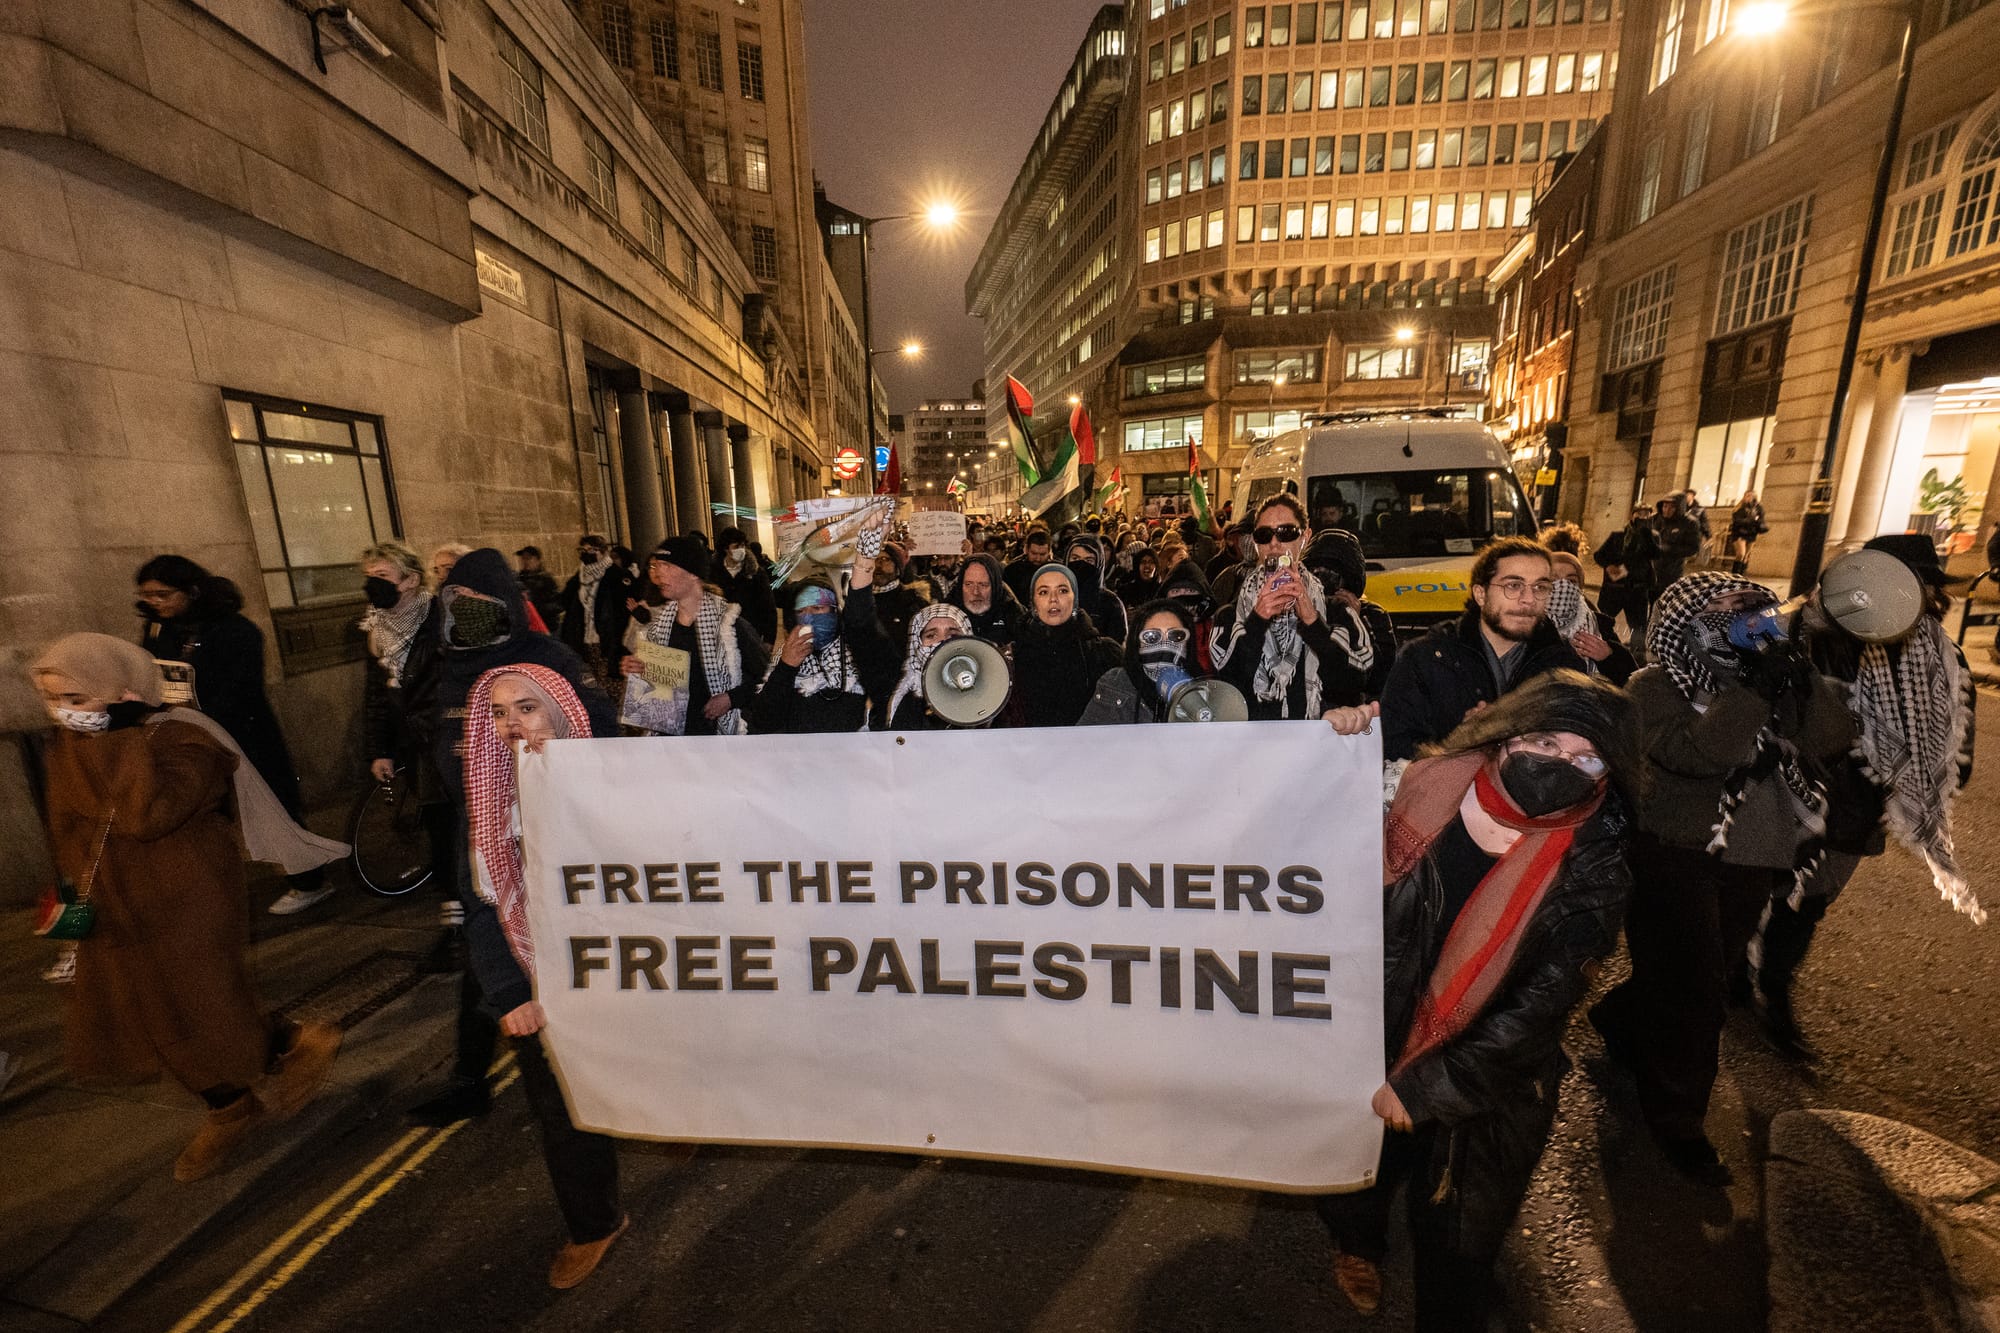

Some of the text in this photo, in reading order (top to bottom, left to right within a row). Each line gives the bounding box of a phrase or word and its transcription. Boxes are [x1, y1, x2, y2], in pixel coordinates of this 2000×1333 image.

[1395, 582, 1467, 596] POLI
[646, 662, 685, 681] CIALISM
[562, 861, 1325, 914] FREE THE PRISONERS
[569, 935, 1333, 1020] FREE PALESTINE
